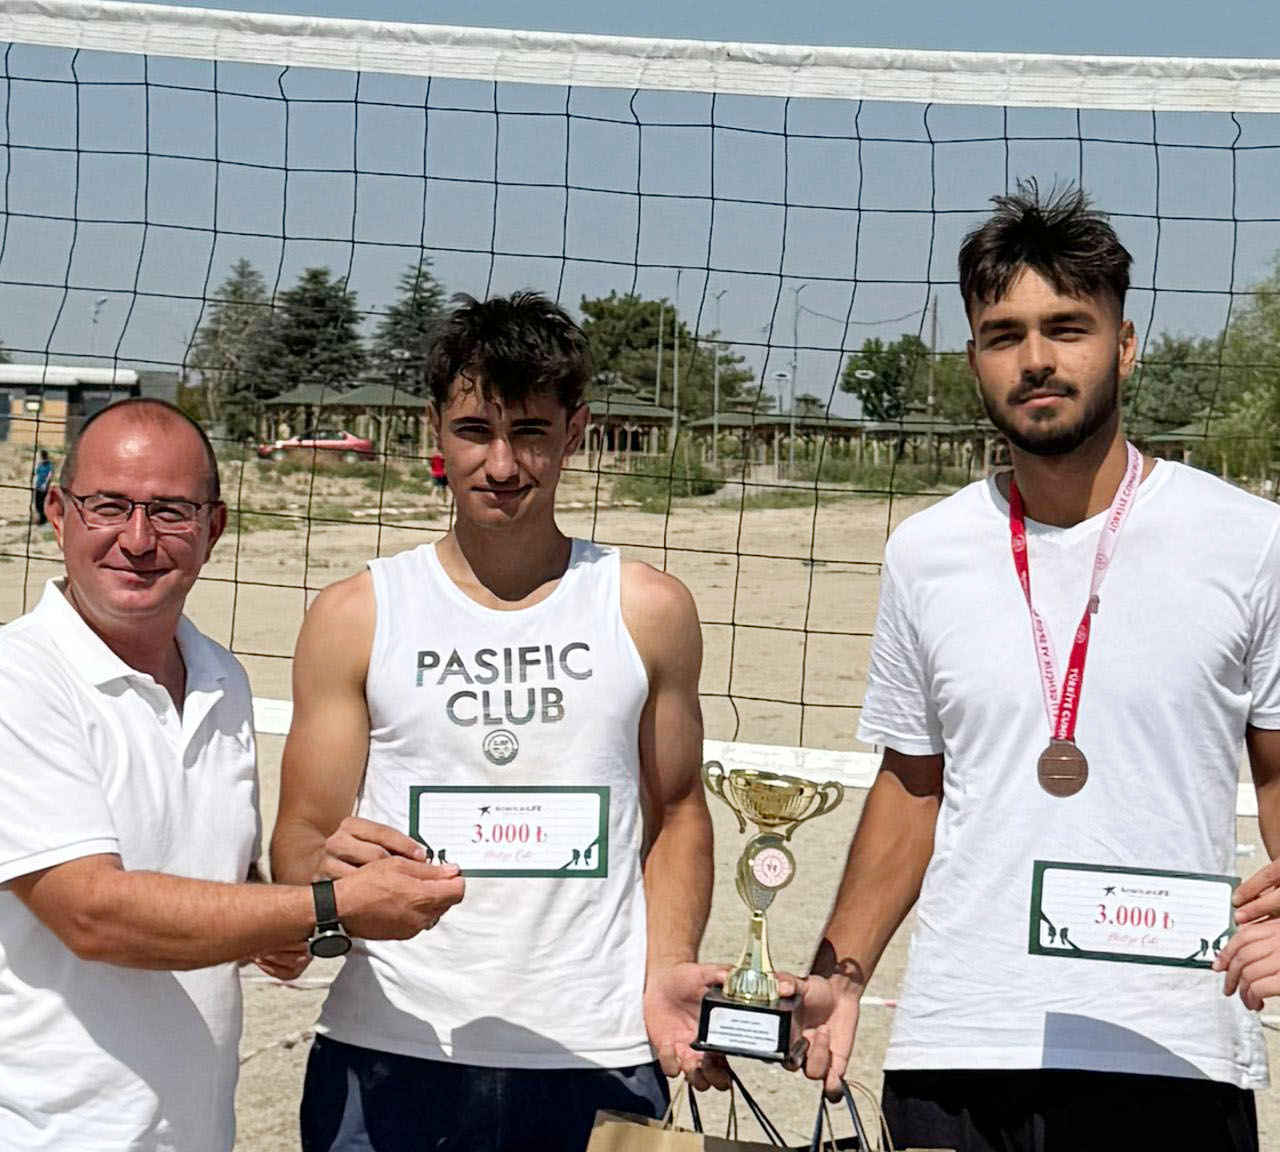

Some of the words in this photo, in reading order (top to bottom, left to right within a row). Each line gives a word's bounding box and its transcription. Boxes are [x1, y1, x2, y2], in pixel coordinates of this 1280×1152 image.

[415, 642, 593, 688] PASIFIC
[446, 687, 565, 727] CLUB
[471, 824, 530, 843] 3.000
[1094, 903, 1157, 928] 3.000
